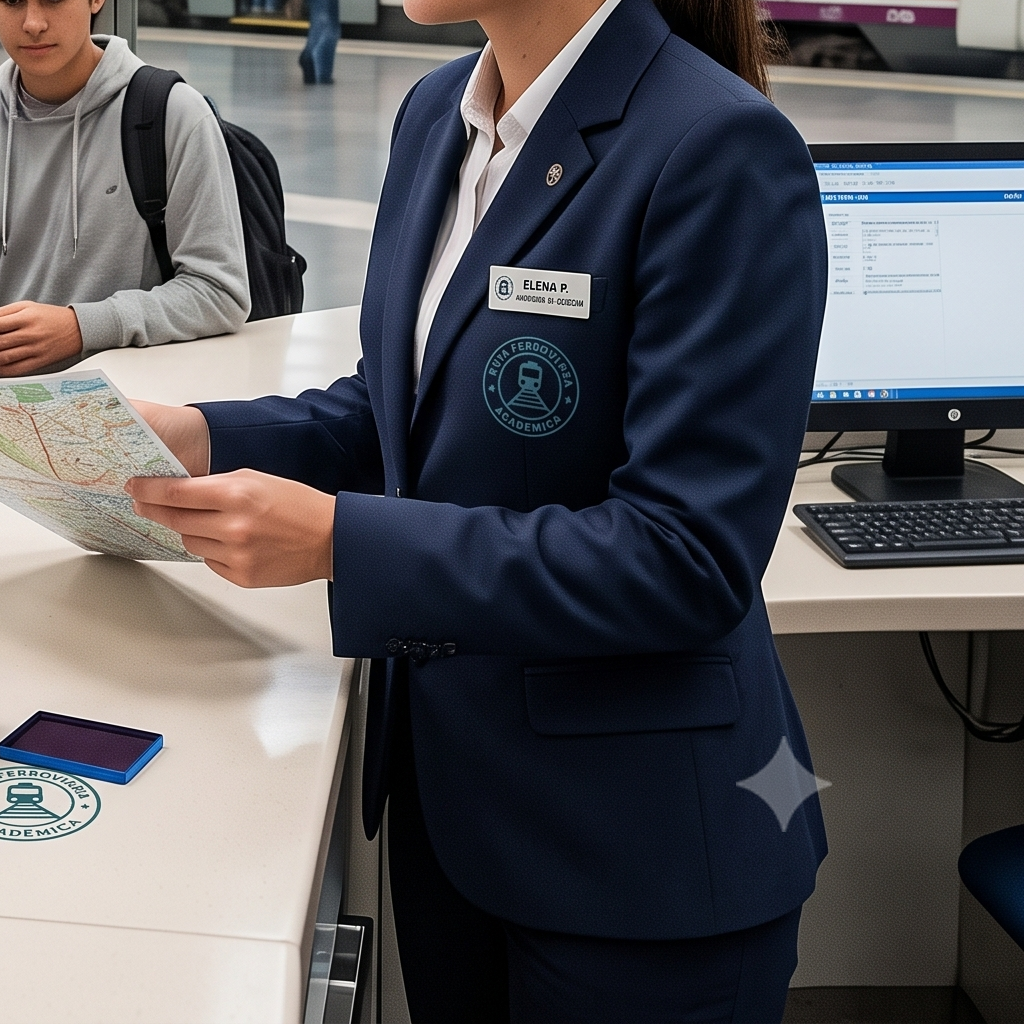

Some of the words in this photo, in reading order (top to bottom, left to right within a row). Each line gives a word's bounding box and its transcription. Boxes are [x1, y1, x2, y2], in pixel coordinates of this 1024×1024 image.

[523, 279, 557, 293] ELENA
[560, 283, 569, 294] P.
[494, 406, 562, 433] ACADEMICA
